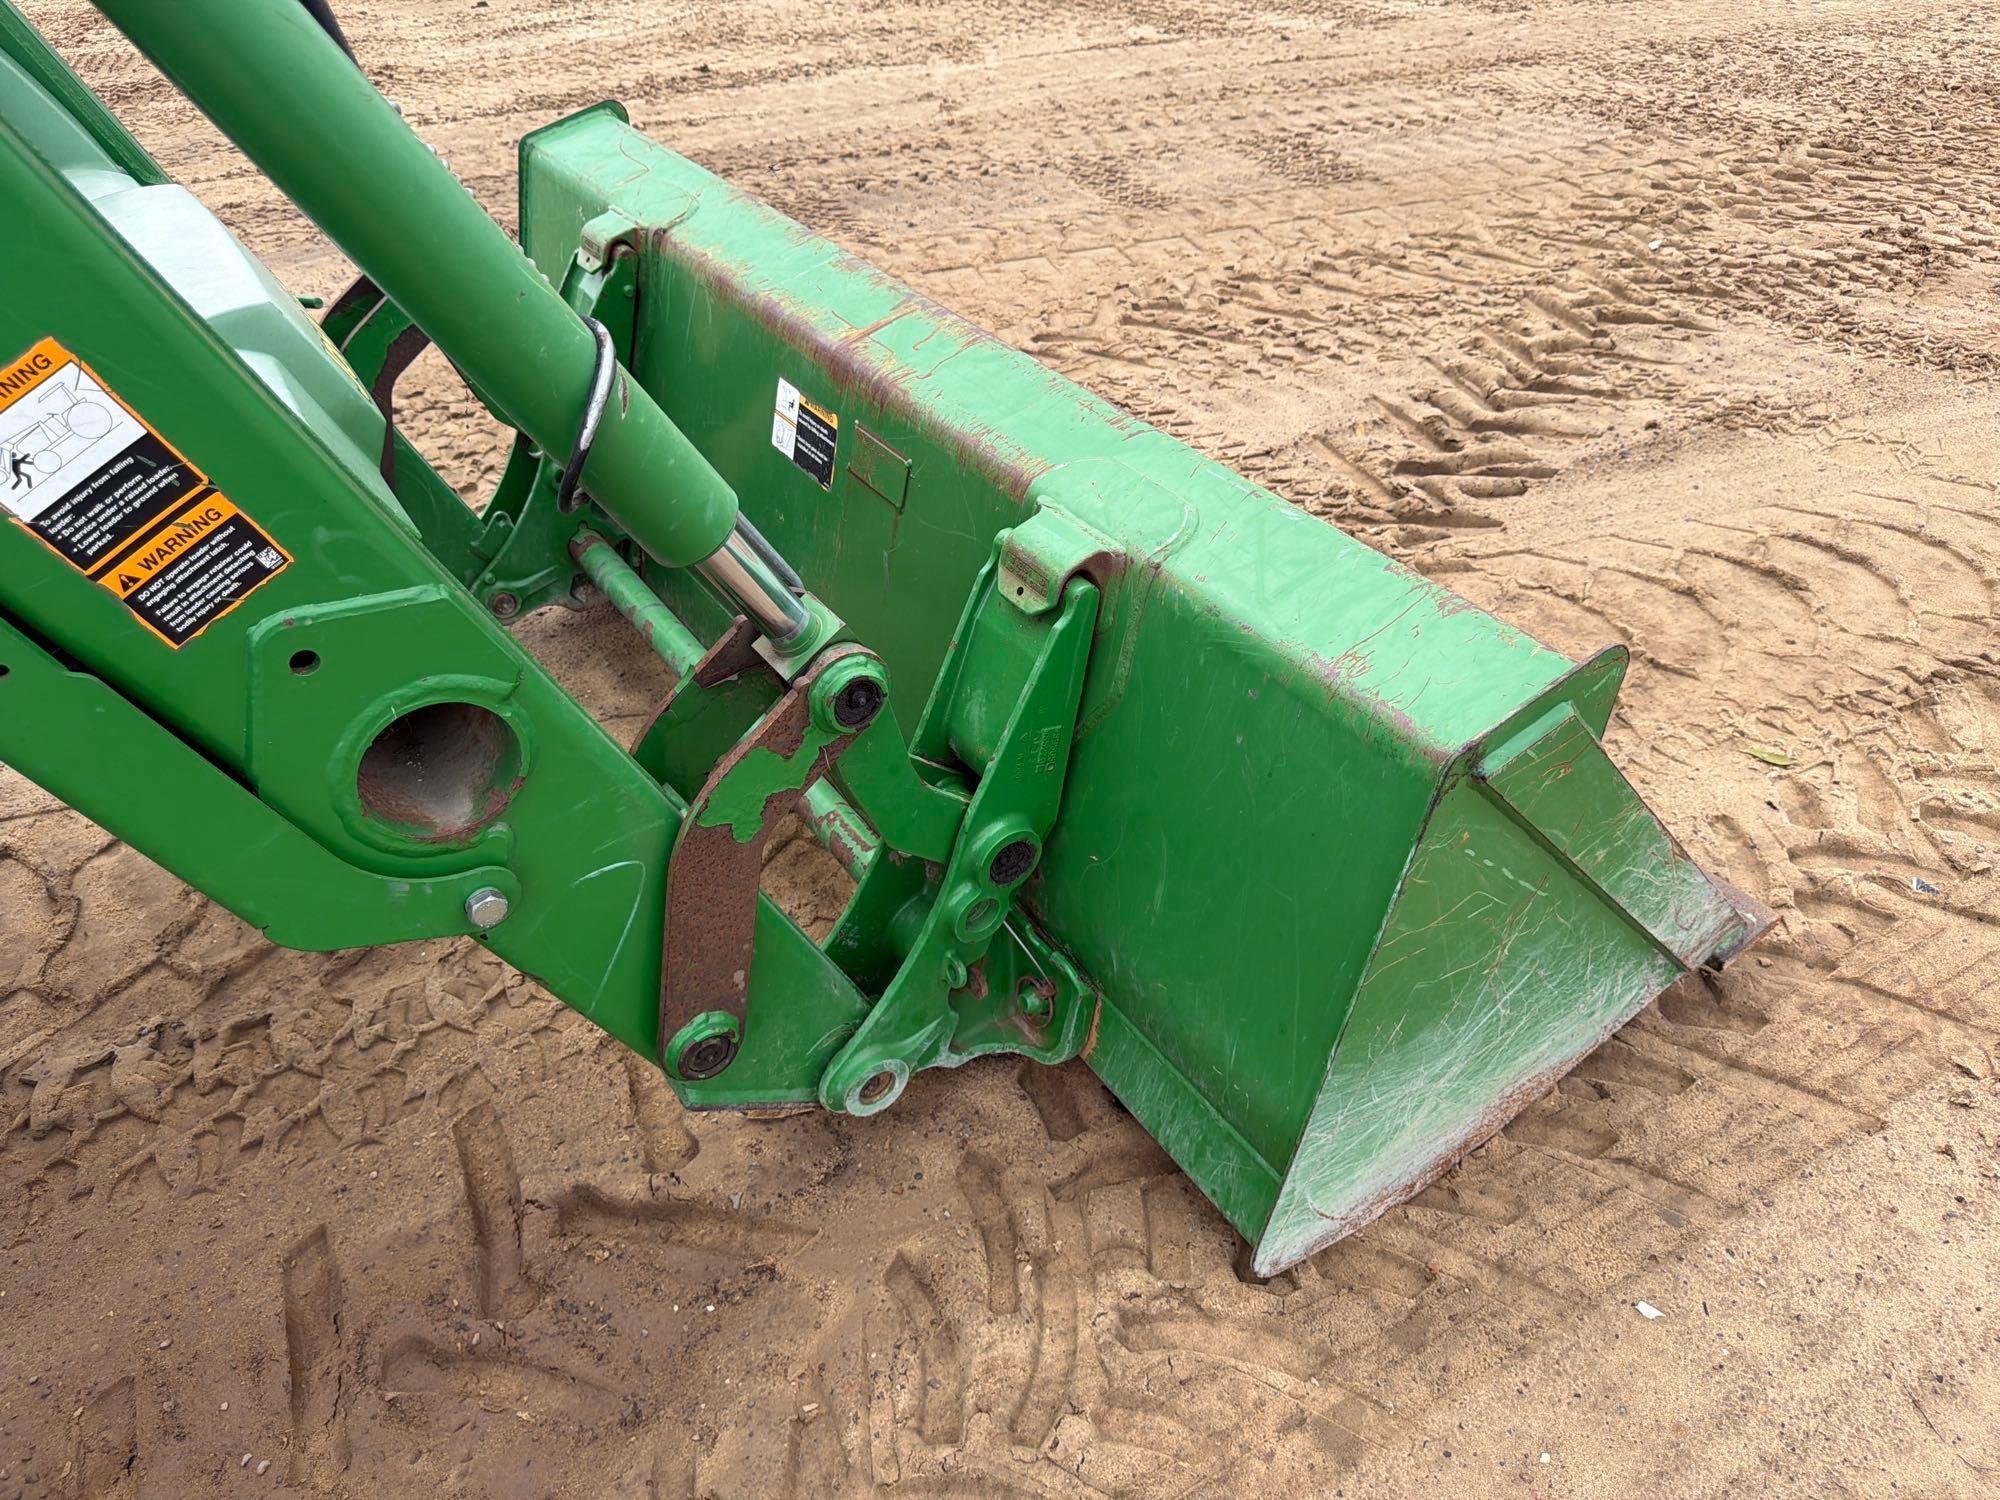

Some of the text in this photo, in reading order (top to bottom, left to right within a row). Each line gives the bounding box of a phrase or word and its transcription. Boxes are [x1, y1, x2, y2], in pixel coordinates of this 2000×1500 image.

[0, 353, 53, 399] NING
[39, 457, 134, 527] To avoid injury from falling
[61, 474, 143, 537] Do not walk or perform
[71, 521, 97, 543] service
[97, 504, 118, 522] under
[124, 482, 148, 502] raised
[77, 473, 179, 549] Lower loader to ground when
[87, 533, 114, 556] parked.
[138, 508, 223, 570] WARNING
[138, 526, 236, 601] DO NOT operate loader without
[146, 543, 230, 607] engaging attachment latch.
[155, 598, 179, 616] Failure
[186, 574, 210, 593] engage
[209, 554, 234, 575] retainer
[234, 540, 253, 556] could
[163, 606, 183, 622] result
[189, 572, 225, 602] attachment
[224, 550, 256, 575] detaching
[170, 614, 186, 627] from
[184, 598, 206, 615] loader
[206, 579, 231, 599] causing
[230, 562, 254, 580] serious
[176, 616, 197, 632] bodily
[195, 600, 217, 617] injury
[221, 582, 242, 597] death.
